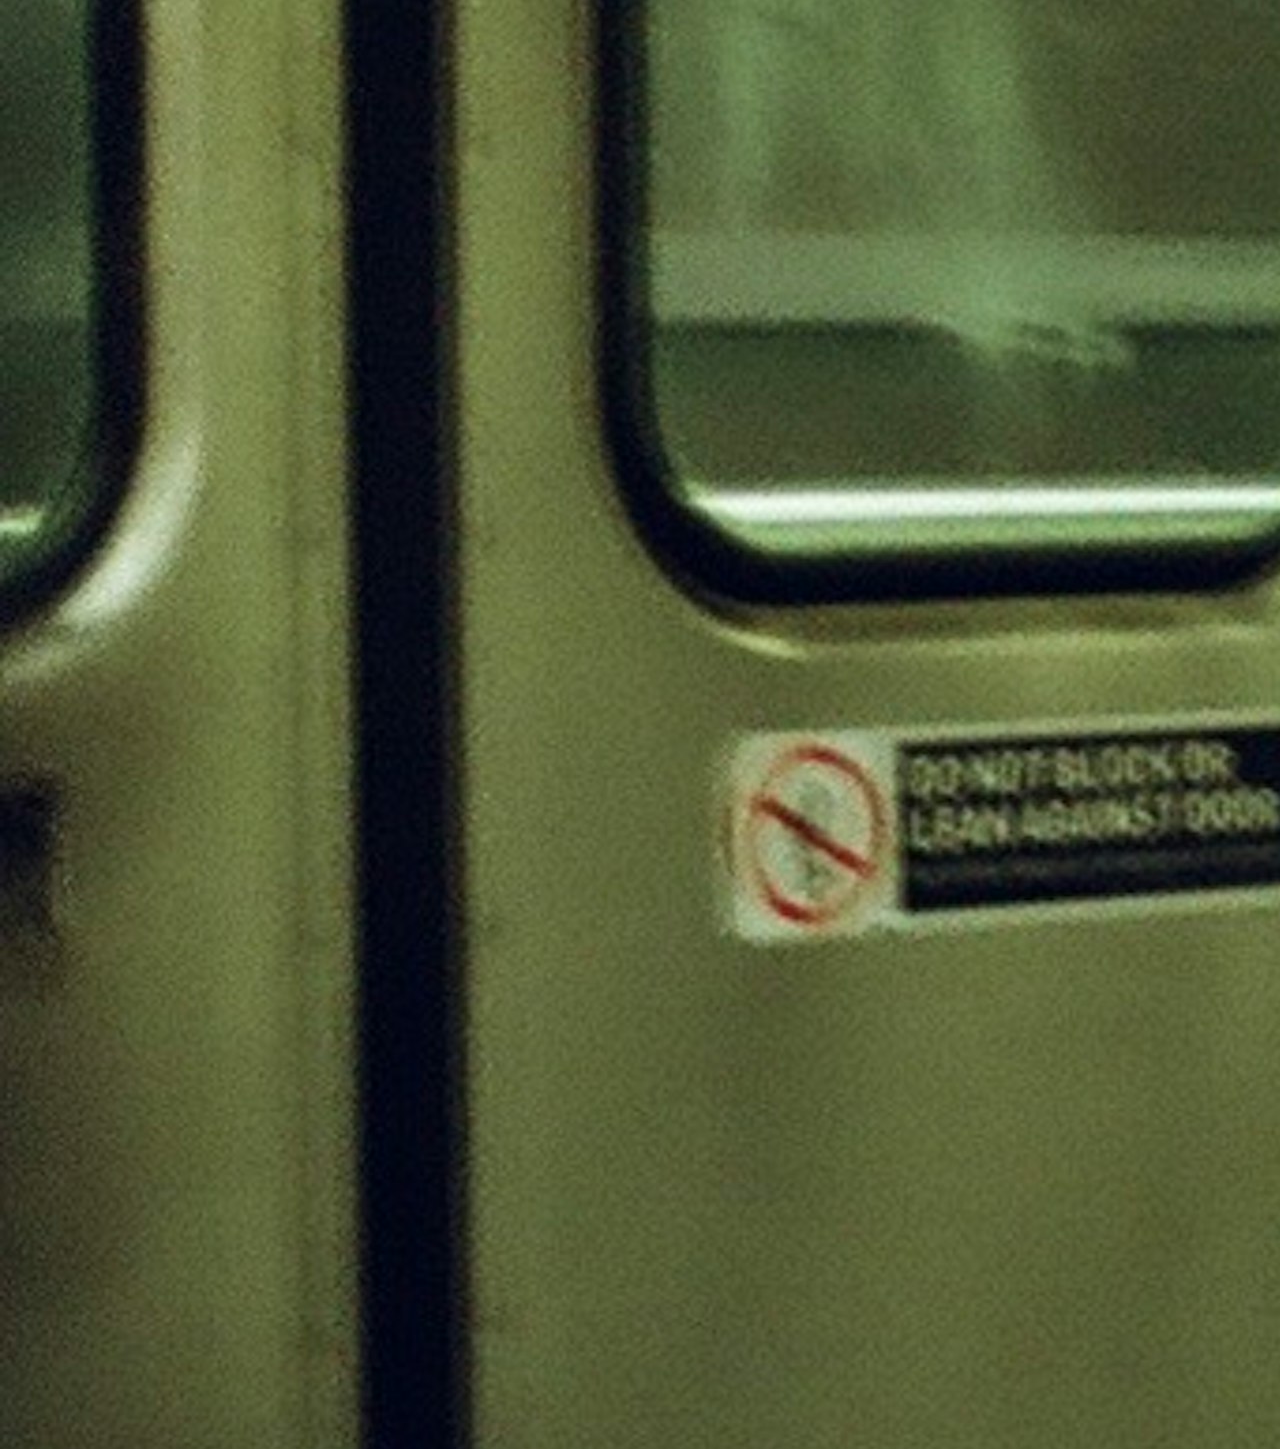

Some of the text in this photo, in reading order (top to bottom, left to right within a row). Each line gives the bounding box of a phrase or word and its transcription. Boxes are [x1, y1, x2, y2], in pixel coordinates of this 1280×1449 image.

[907, 738, 1238, 799] DO NOT BLOCK OR
[907, 801, 1010, 851] LEAN
[1020, 792, 1172, 845] AGAINST
